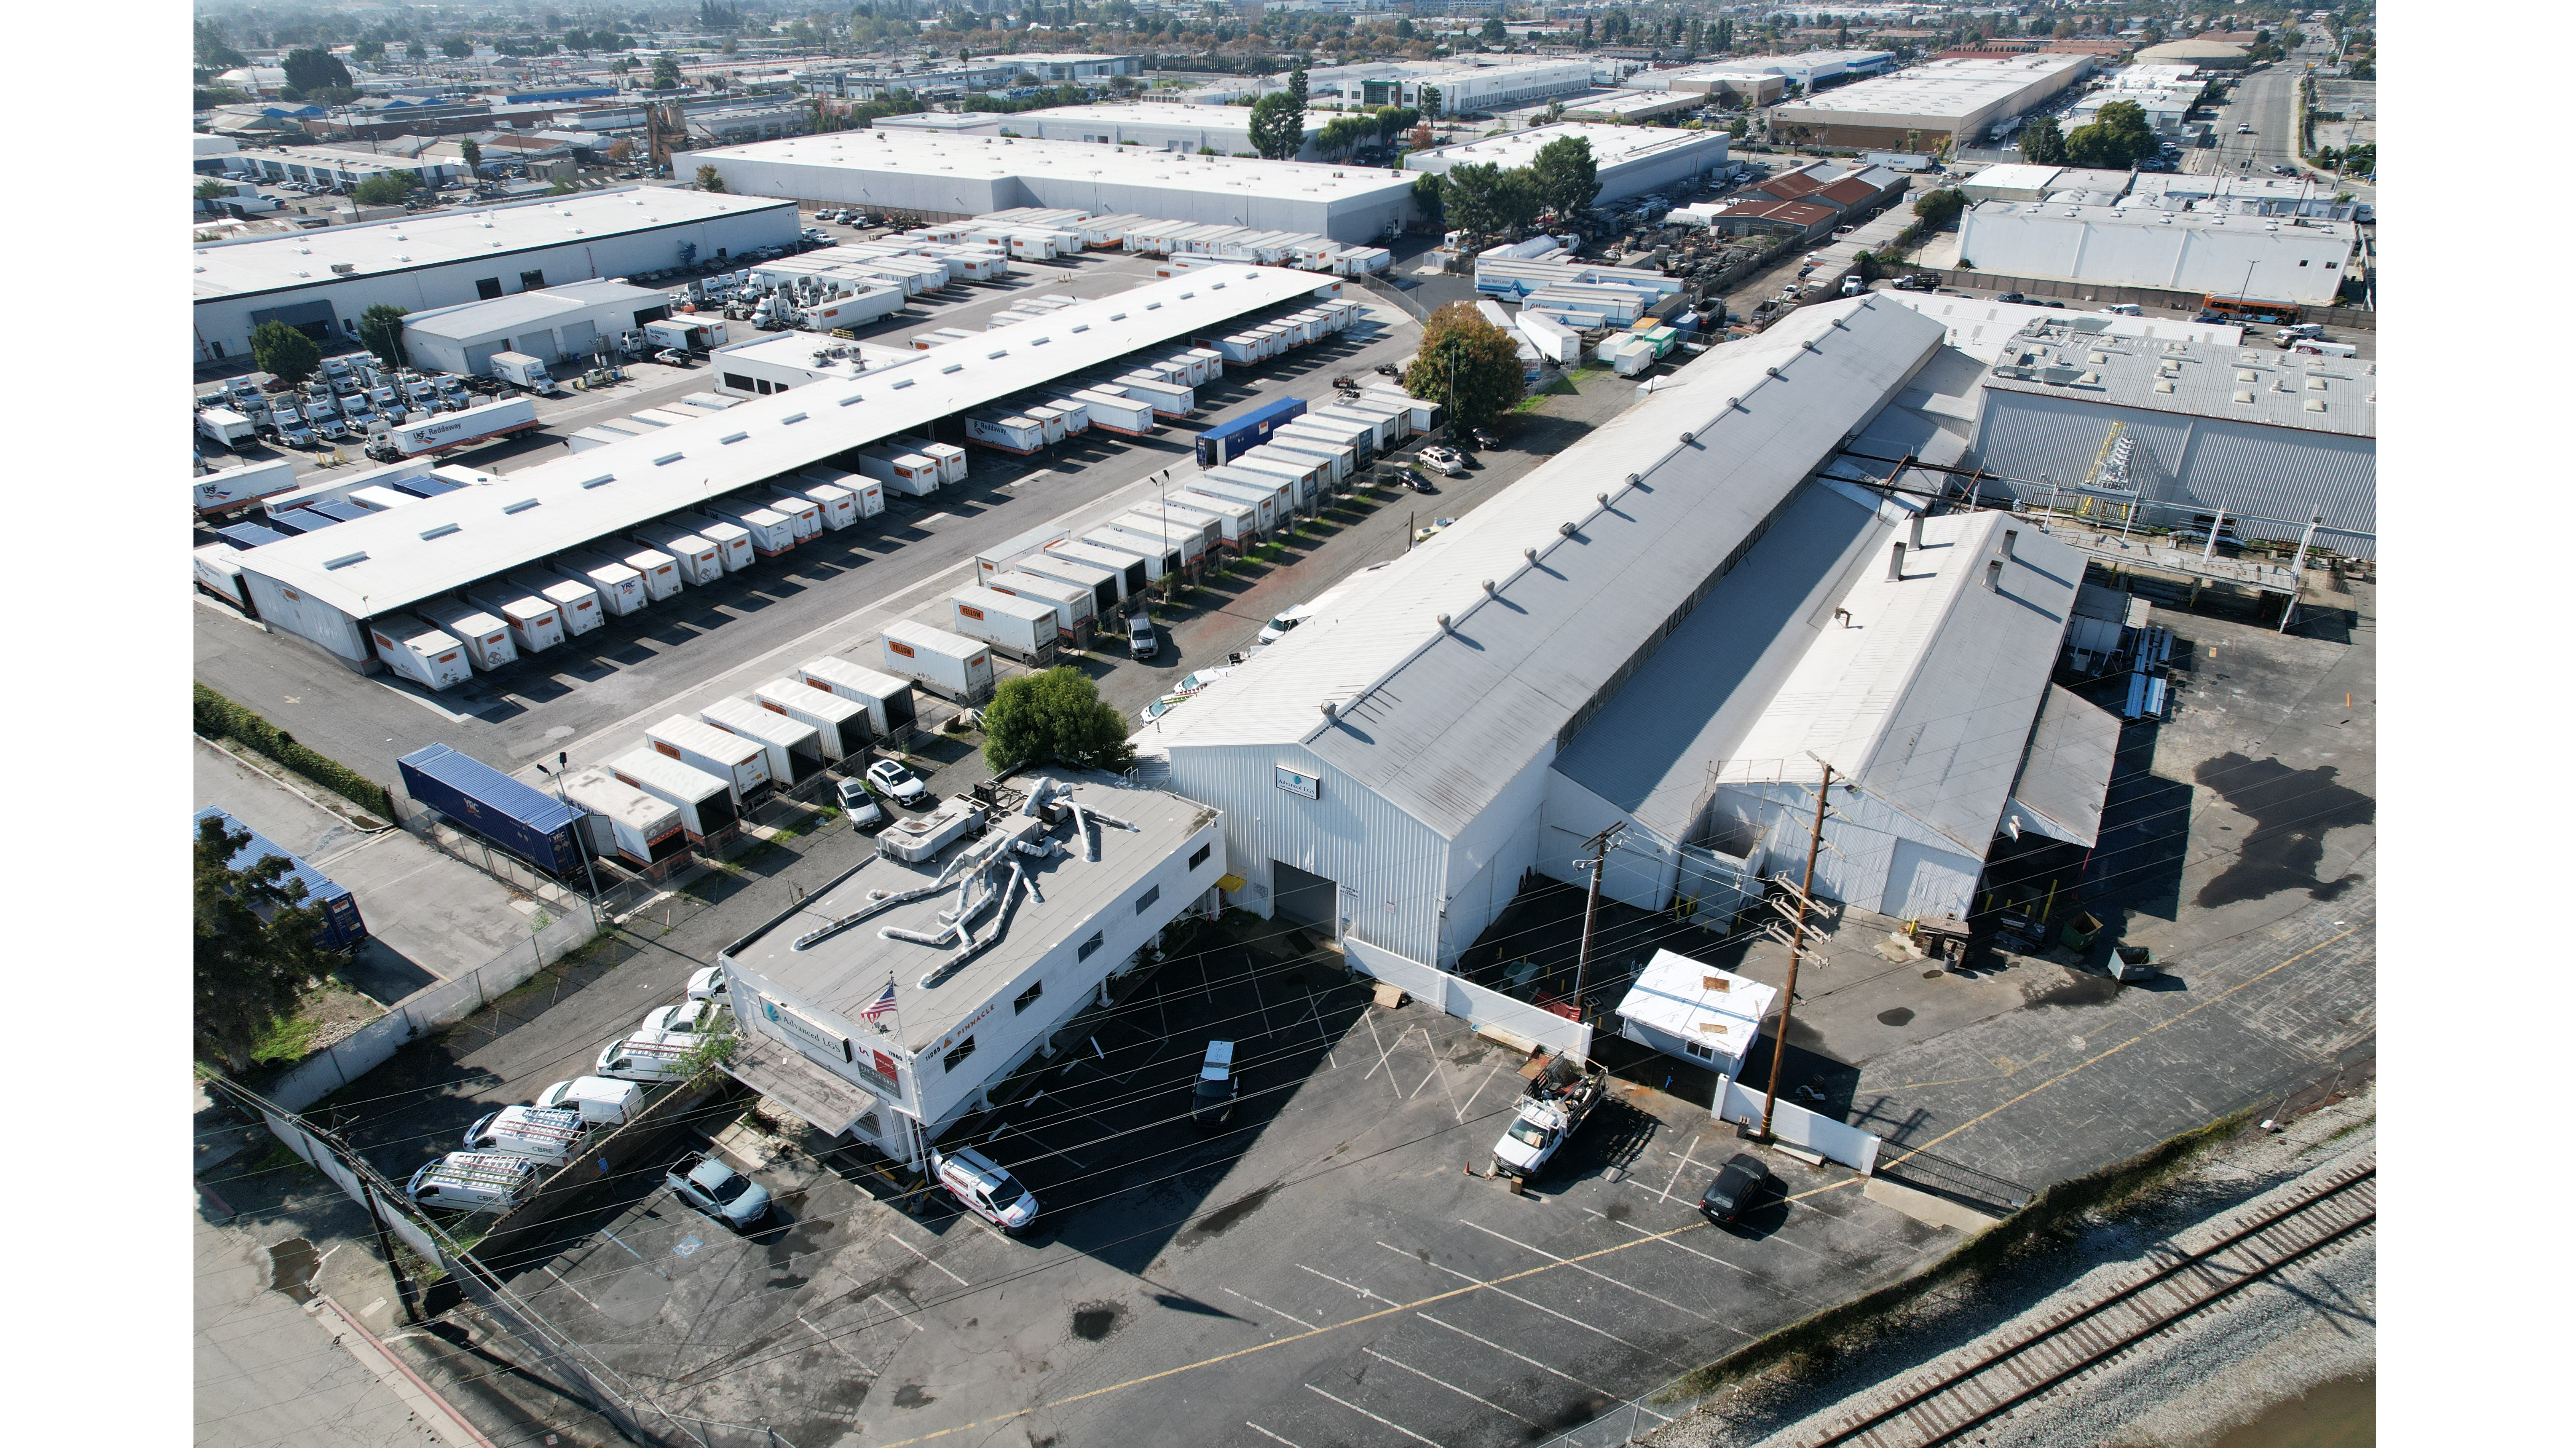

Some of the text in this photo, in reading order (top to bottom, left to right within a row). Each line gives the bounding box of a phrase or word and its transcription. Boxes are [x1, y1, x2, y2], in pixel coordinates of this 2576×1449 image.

[413, 423, 461, 440] USF Reddaway
[981, 423, 1006, 435] Reddaway
[896, 468, 910, 476] YELLOW
[202, 484, 217, 494] USF
[621, 580, 635, 590] YRC
[962, 607, 980, 618] YELLOW
[892, 644, 911, 655] YELLOW
[810, 680, 828, 692] YELLOW
[765, 703, 783, 715] YELLOW
[657, 743, 677, 757] YELLOW
[618, 776, 637, 788] YELLOW
[1278, 779, 1302, 790] Advanced
[464, 798, 479, 812] YRC
[1653, 979, 1663, 988] Tyvek
[1689, 982, 1698, 991] Tyvek
[957, 1004, 994, 1037] PINNACLE
[1669, 1013, 1679, 1023] Tyvek
[783, 1016, 840, 1052] Advanced LGS
[1738, 1029, 1748, 1039] Tyvek
[888, 1050, 903, 1061] 11905
[925, 1046, 941, 1061] 11905
[876, 1058, 894, 1070] AVAILABLE
[860, 1065, 896, 1088] 323.922.3832
